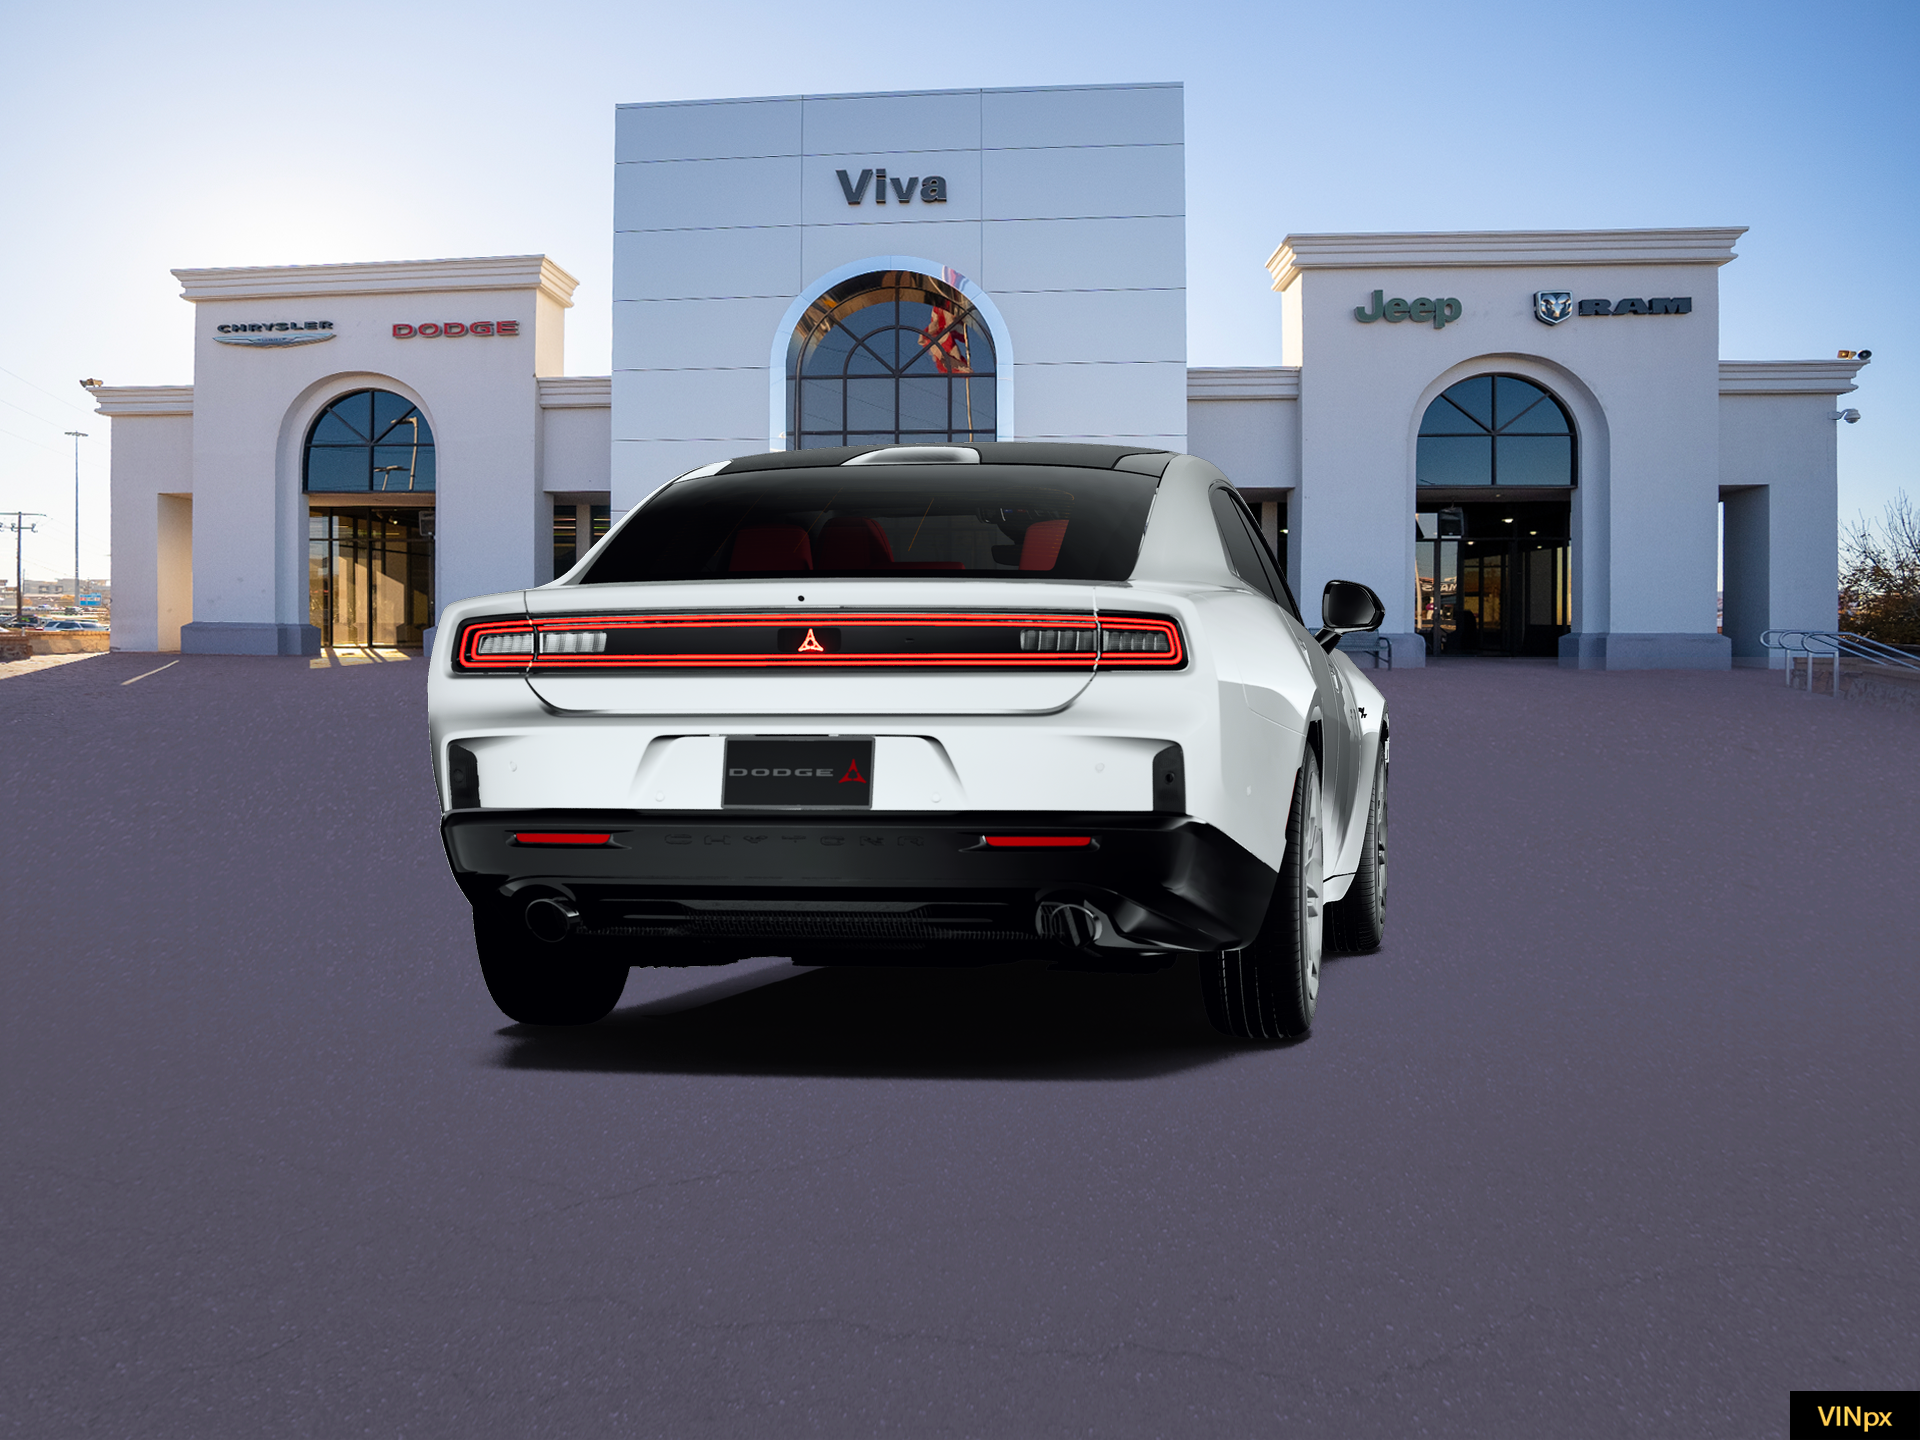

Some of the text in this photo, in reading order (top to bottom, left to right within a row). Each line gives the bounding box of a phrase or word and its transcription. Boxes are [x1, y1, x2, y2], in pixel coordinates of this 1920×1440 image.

[835, 168, 947, 205] Viva
[1354, 290, 1463, 329] Jeep
[1578, 296, 1692, 316] RAM
[217, 320, 334, 334] CHRYSLER
[392, 320, 520, 338] DODGE
[729, 767, 835, 778] DODGE
